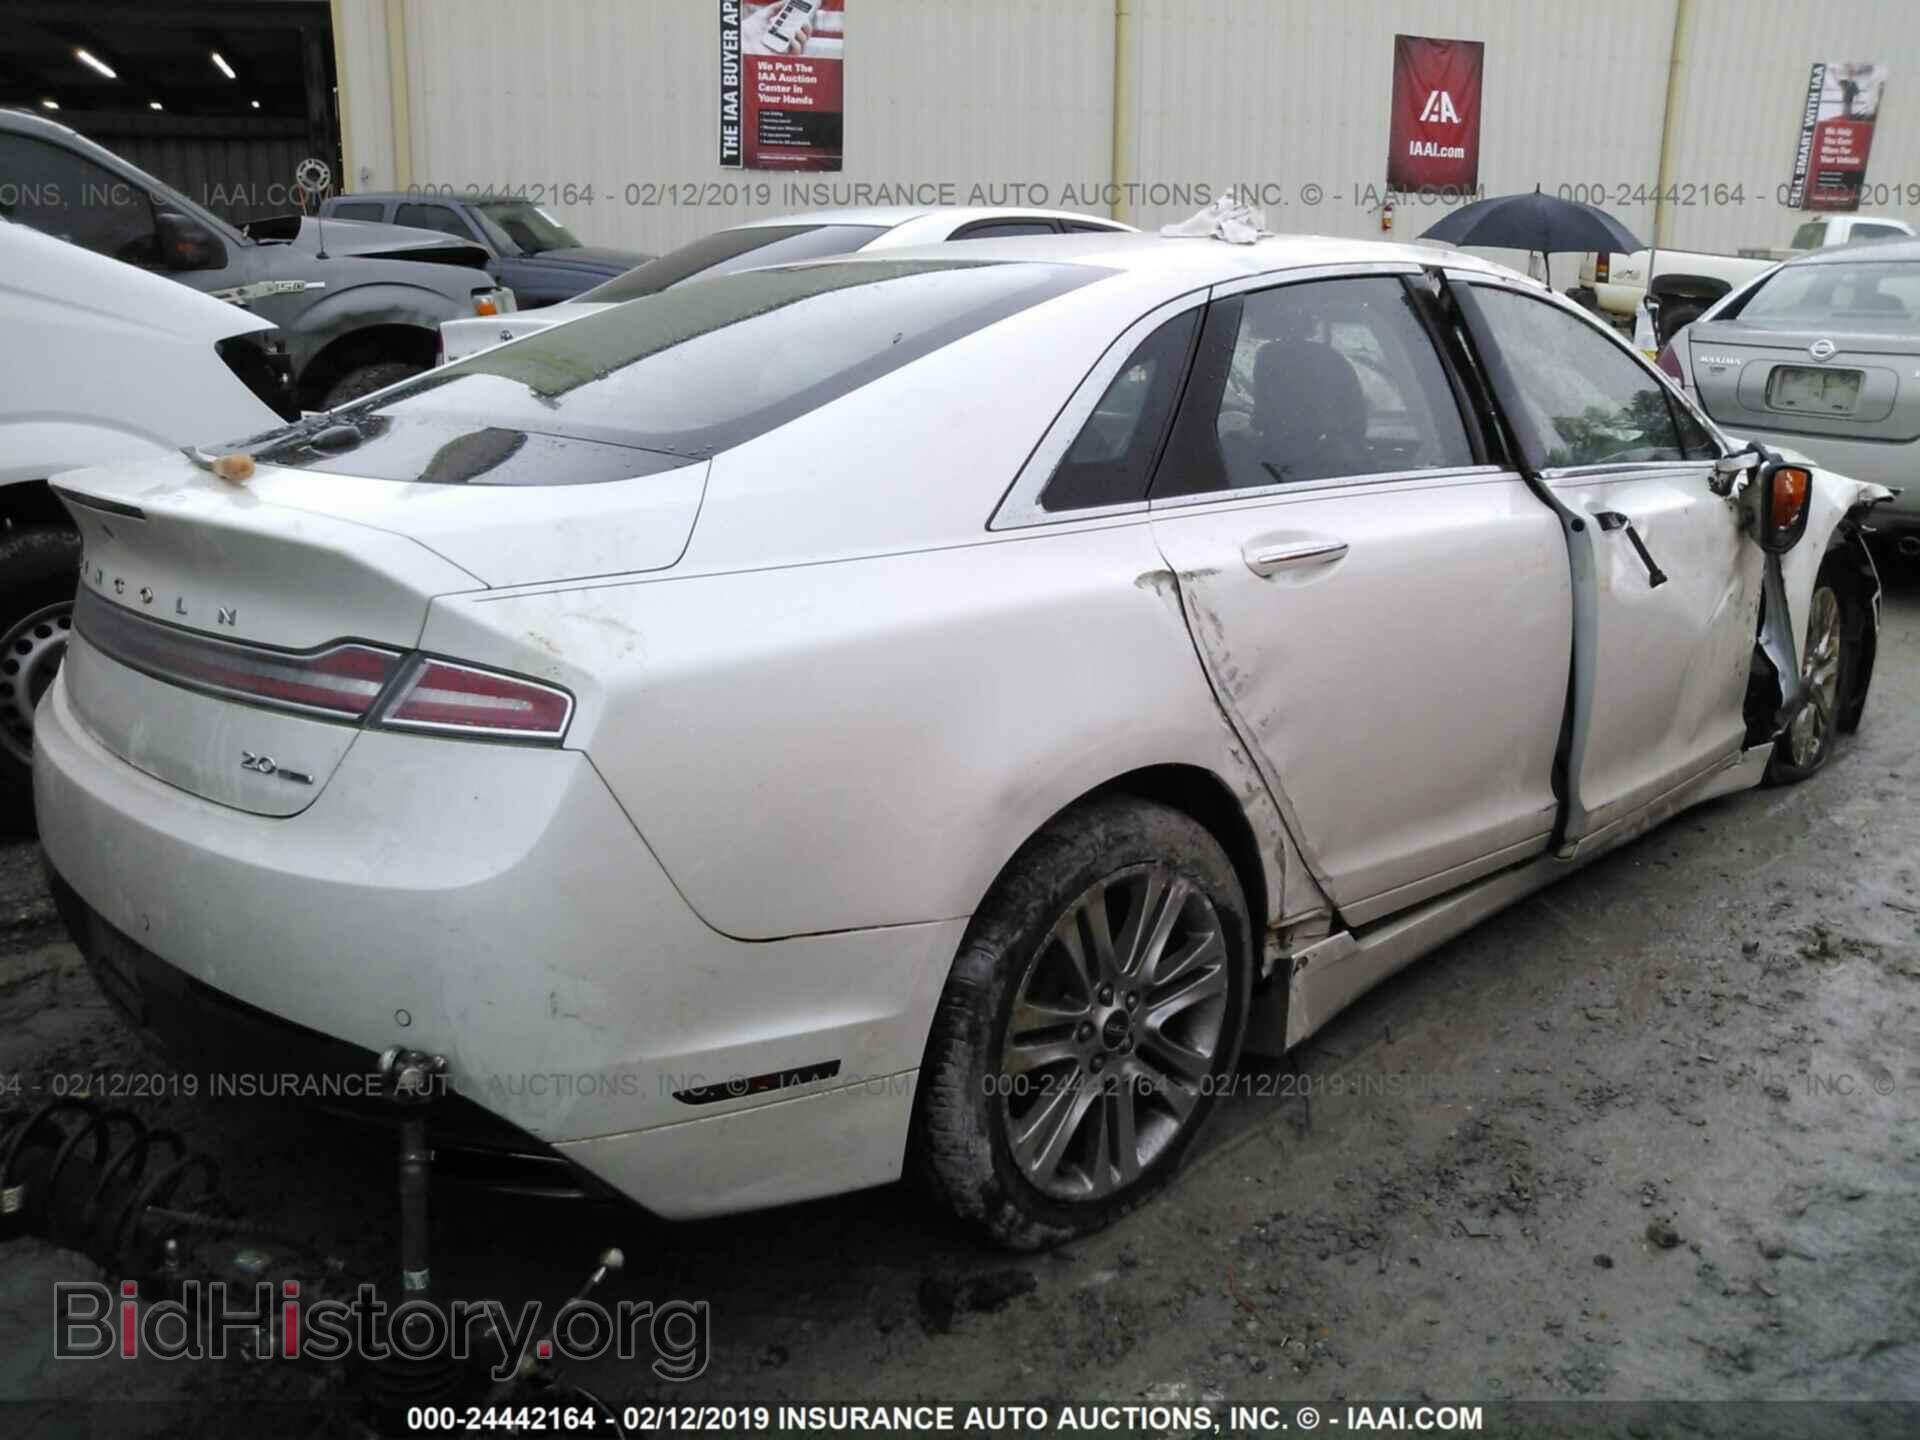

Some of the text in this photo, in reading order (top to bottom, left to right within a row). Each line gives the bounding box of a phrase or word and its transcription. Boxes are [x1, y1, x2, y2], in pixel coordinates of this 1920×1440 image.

[723, 30, 739, 86] BUYER
[757, 61, 814, 73] We Put The
[758, 72, 818, 84] IAA Auction
[758, 83, 791, 94] Center
[723, 91, 739, 121] IAA
[758, 93, 814, 105] Your Hands
[723, 125, 739, 158] THE
[1788, 66, 1825, 206] SELL SMART WITH IAA
[1409, 140, 1465, 159] IAAI.com
[80, 556, 237, 626] INCOLN
